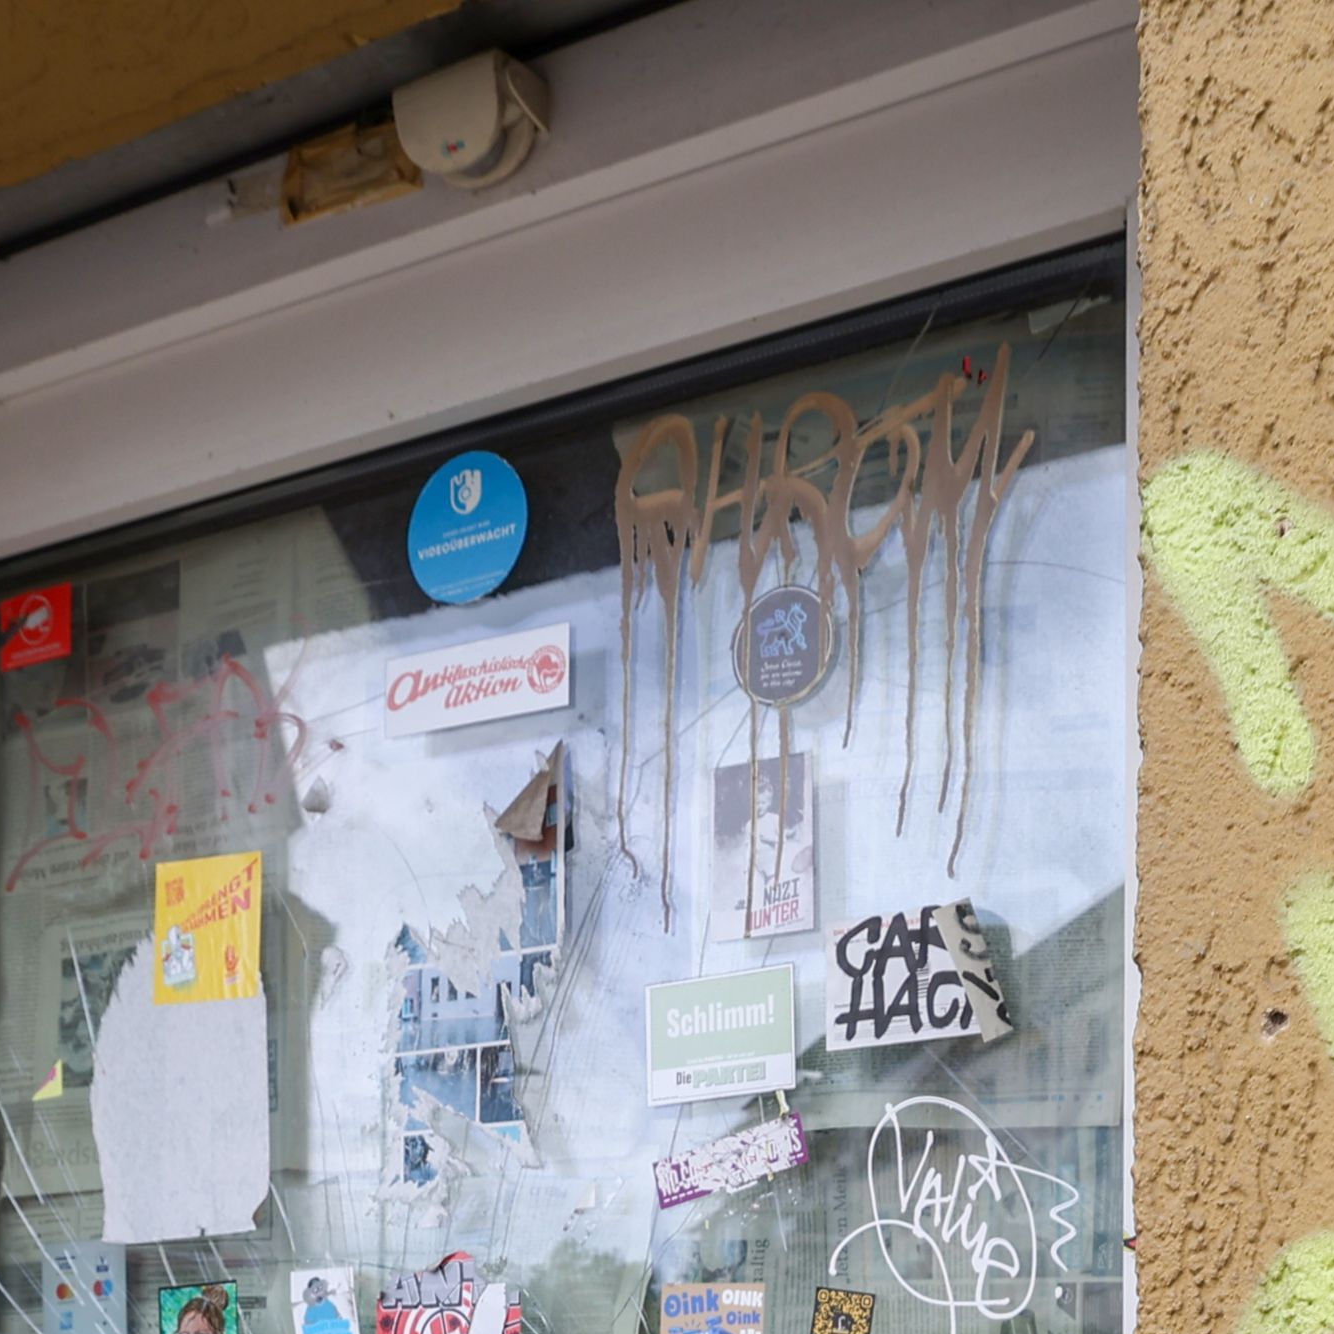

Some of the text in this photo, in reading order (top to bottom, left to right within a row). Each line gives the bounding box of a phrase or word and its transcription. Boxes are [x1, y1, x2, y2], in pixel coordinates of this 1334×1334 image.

[417, 523, 516, 561] VIDEOÜBERWACHT
[763, 877, 800, 907] NAZI
[666, 994, 775, 1039] Schlimm!
[676, 1060, 767, 1089] Die PARTEI
[664, 1288, 764, 1317] Oink OINK
[726, 1311, 761, 1326] Oink
